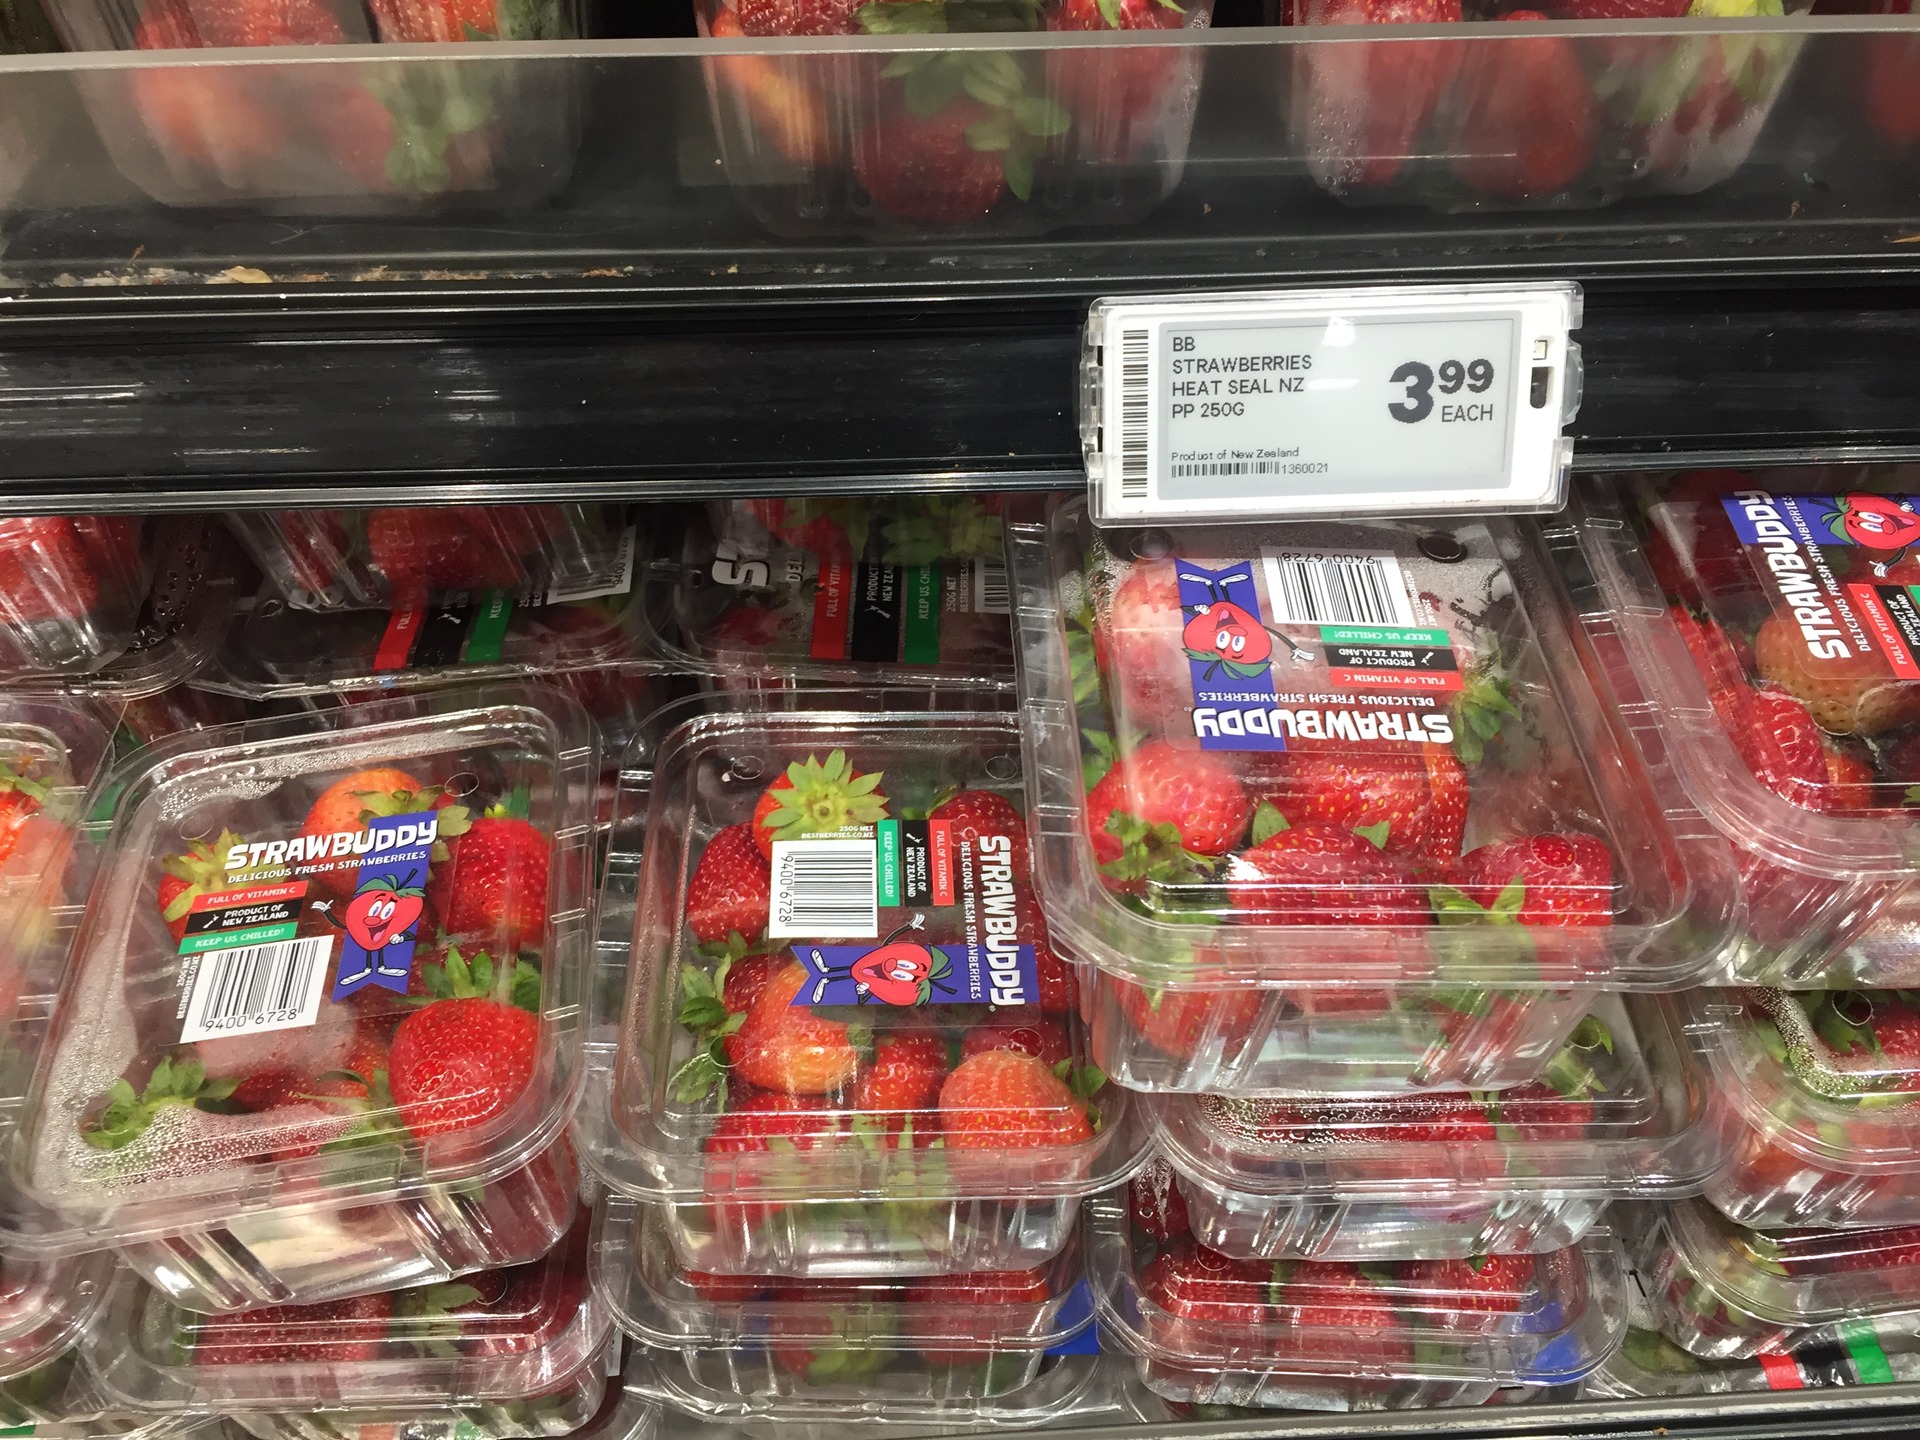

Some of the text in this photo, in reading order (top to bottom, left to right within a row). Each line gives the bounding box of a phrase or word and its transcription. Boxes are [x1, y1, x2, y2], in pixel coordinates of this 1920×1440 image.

[1172, 336, 1196, 352] BB
[1172, 354, 1312, 375] STRAWBERRIES
[1172, 376, 1305, 397] HEAT SEAL NZ
[1387, 357, 1495, 424] 3 99
[1172, 402, 1245, 420] PP 250G
[1441, 404, 1494, 424] EACH
[1172, 446, 1300, 461] Product of New Zealand
[1281, 462, 1329, 474] 1360021
[1281, 552, 1376, 566] 9400 6728
[1734, 490, 1852, 660] STRAWBUDDY
[1782, 494, 1872, 652] DELICIOUS FRESH STRAWBERRIES
[828, 586, 840, 598] OF
[882, 586, 893, 602] NEW
[920, 586, 930, 596] US
[946, 576, 957, 612] 250G NET
[826, 599, 838, 618] FULL
[918, 598, 930, 620] KEEP
[1864, 600, 1889, 632] VITAMIN
[1886, 599, 1920, 646] PRODUCT OF
[1334, 631, 1432, 641] KEEP US CHILLED!
[1883, 632, 1896, 644] OF
[1338, 648, 1414, 658] NEW ZEALAND
[1349, 657, 1416, 667] PRODUCT OF
[1890, 644, 1908, 665] FULL
[1343, 674, 1446, 685] FULL OF VITAMIN C
[1198, 692, 1436, 707] DELICIOUS FRESH STRAWBERRIES
[1192, 707, 1454, 744] STRAWBUDDY
[800, 831, 874, 839] BESTBERRIES.CO.NZ
[936, 830, 946, 847] FULL
[224, 820, 438, 871] STRAWBUDDY
[938, 848, 946, 858] OF
[227, 850, 427, 884] DELICIOUS FRESH STRAWBERRIES
[884, 831, 894, 898] KEEP US CHILLED!
[906, 846, 916, 898] NEW ZEALAND
[916, 846, 926, 892] PRODUCT OF
[938, 858, 948, 890] VITAMIN
[207, 886, 296, 904] FULL OF VITAMIN C
[778, 856, 794, 922] 9400 6728
[222, 910, 290, 926] NEW ZEALAND
[224, 904, 284, 918] PRODUCT OF
[960, 841, 982, 1000] DELICIOUS FRESH STRAWBERRIES
[979, 836, 1026, 1006] STRAWBUDDY
[194, 928, 285, 948] KEEP US CHILLED!
[205, 1009, 298, 1032] 9400 6728
